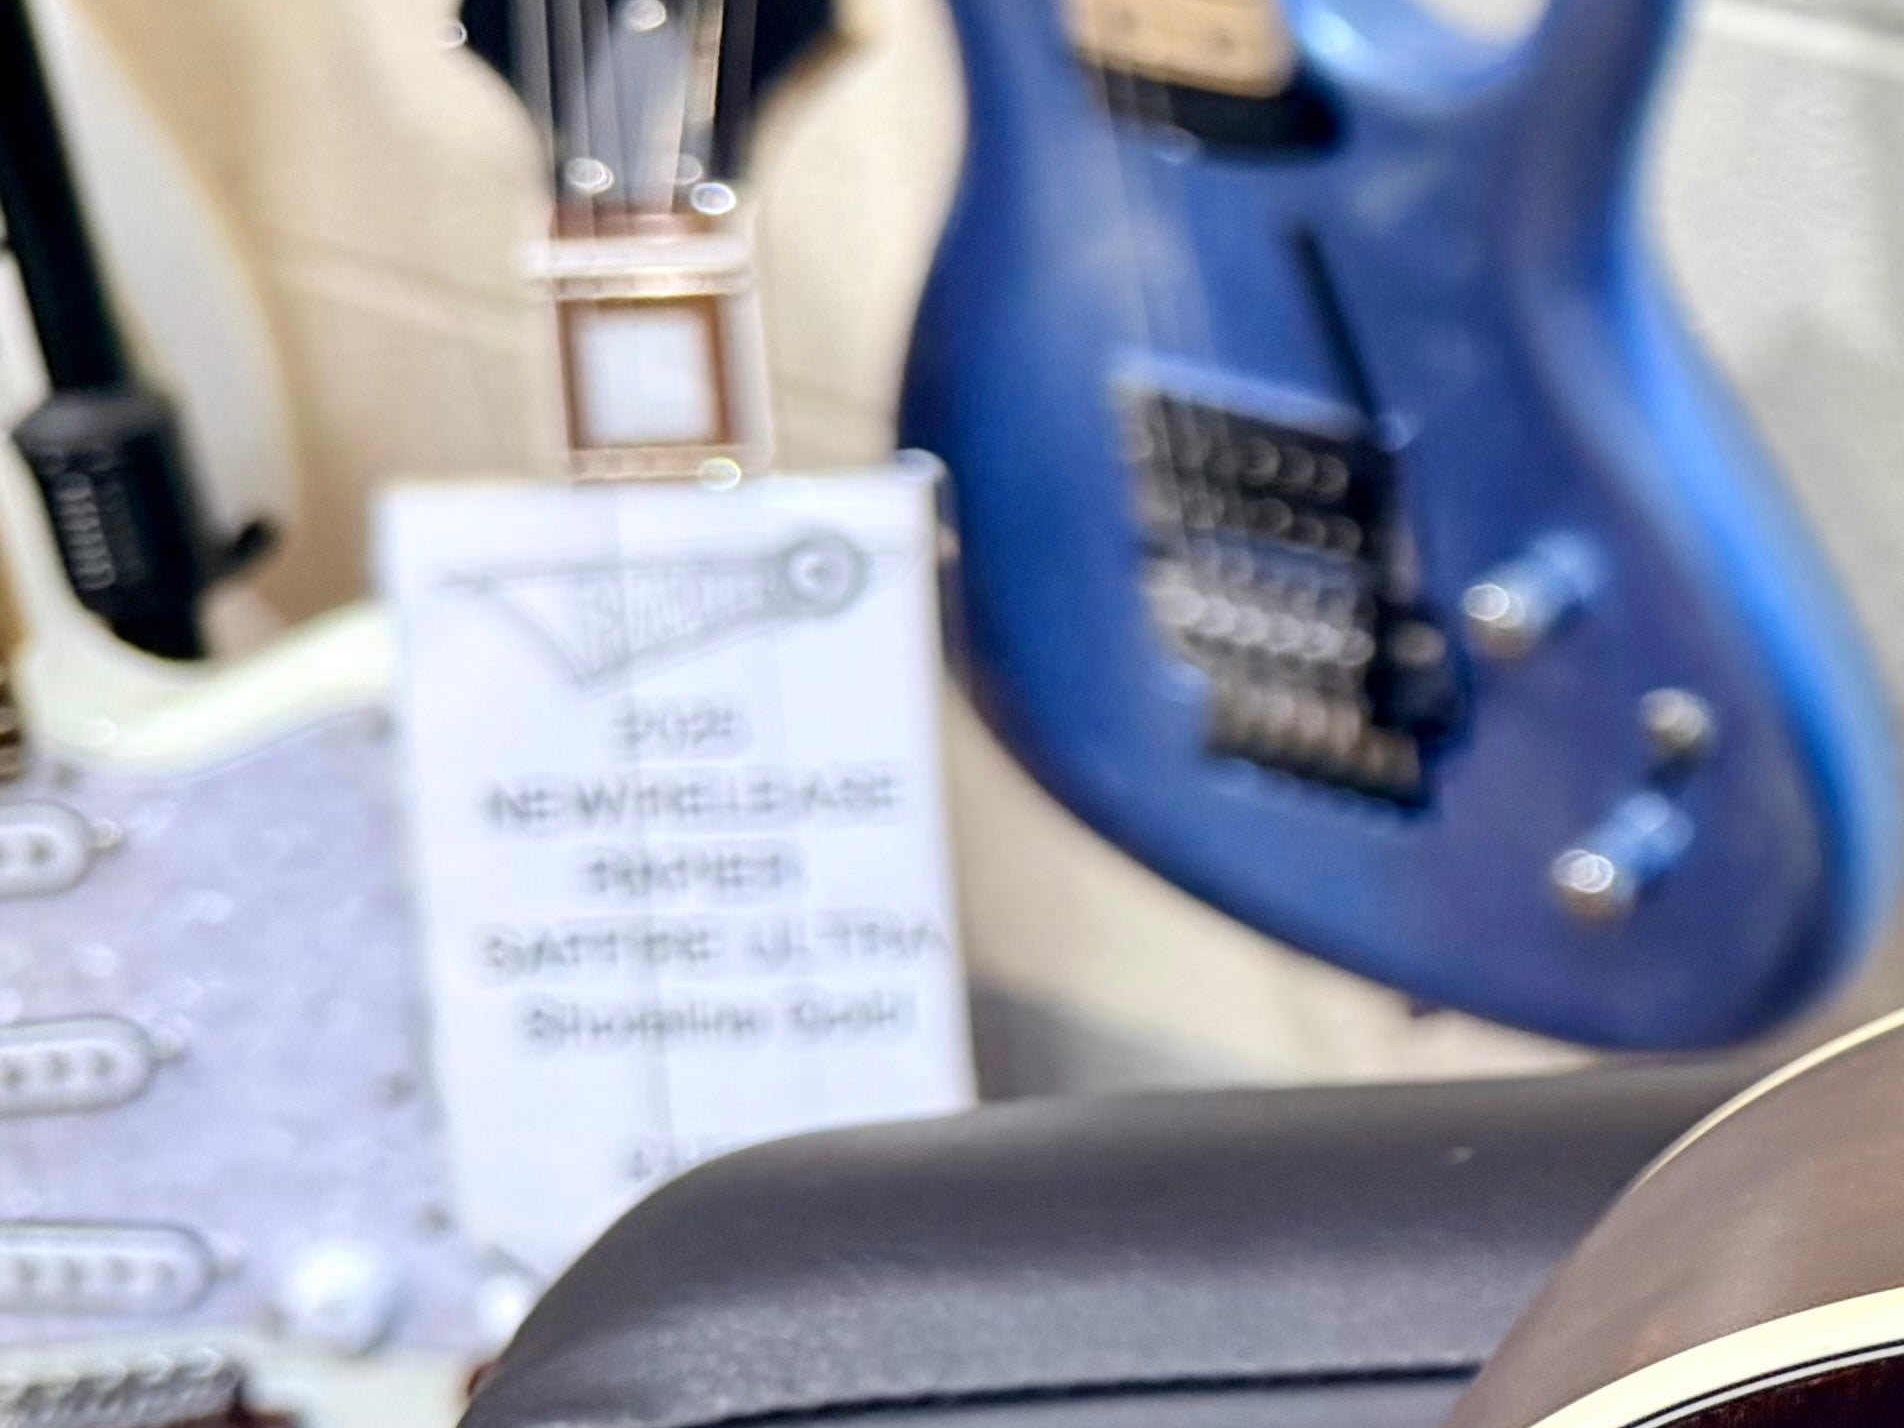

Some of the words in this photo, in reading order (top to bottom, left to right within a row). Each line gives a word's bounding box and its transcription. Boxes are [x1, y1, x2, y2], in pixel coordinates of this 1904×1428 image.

[480, 778, 617, 831] NEW
[629, 766, 906, 825] RELEASE
[743, 915, 938, 969] ULTRA
